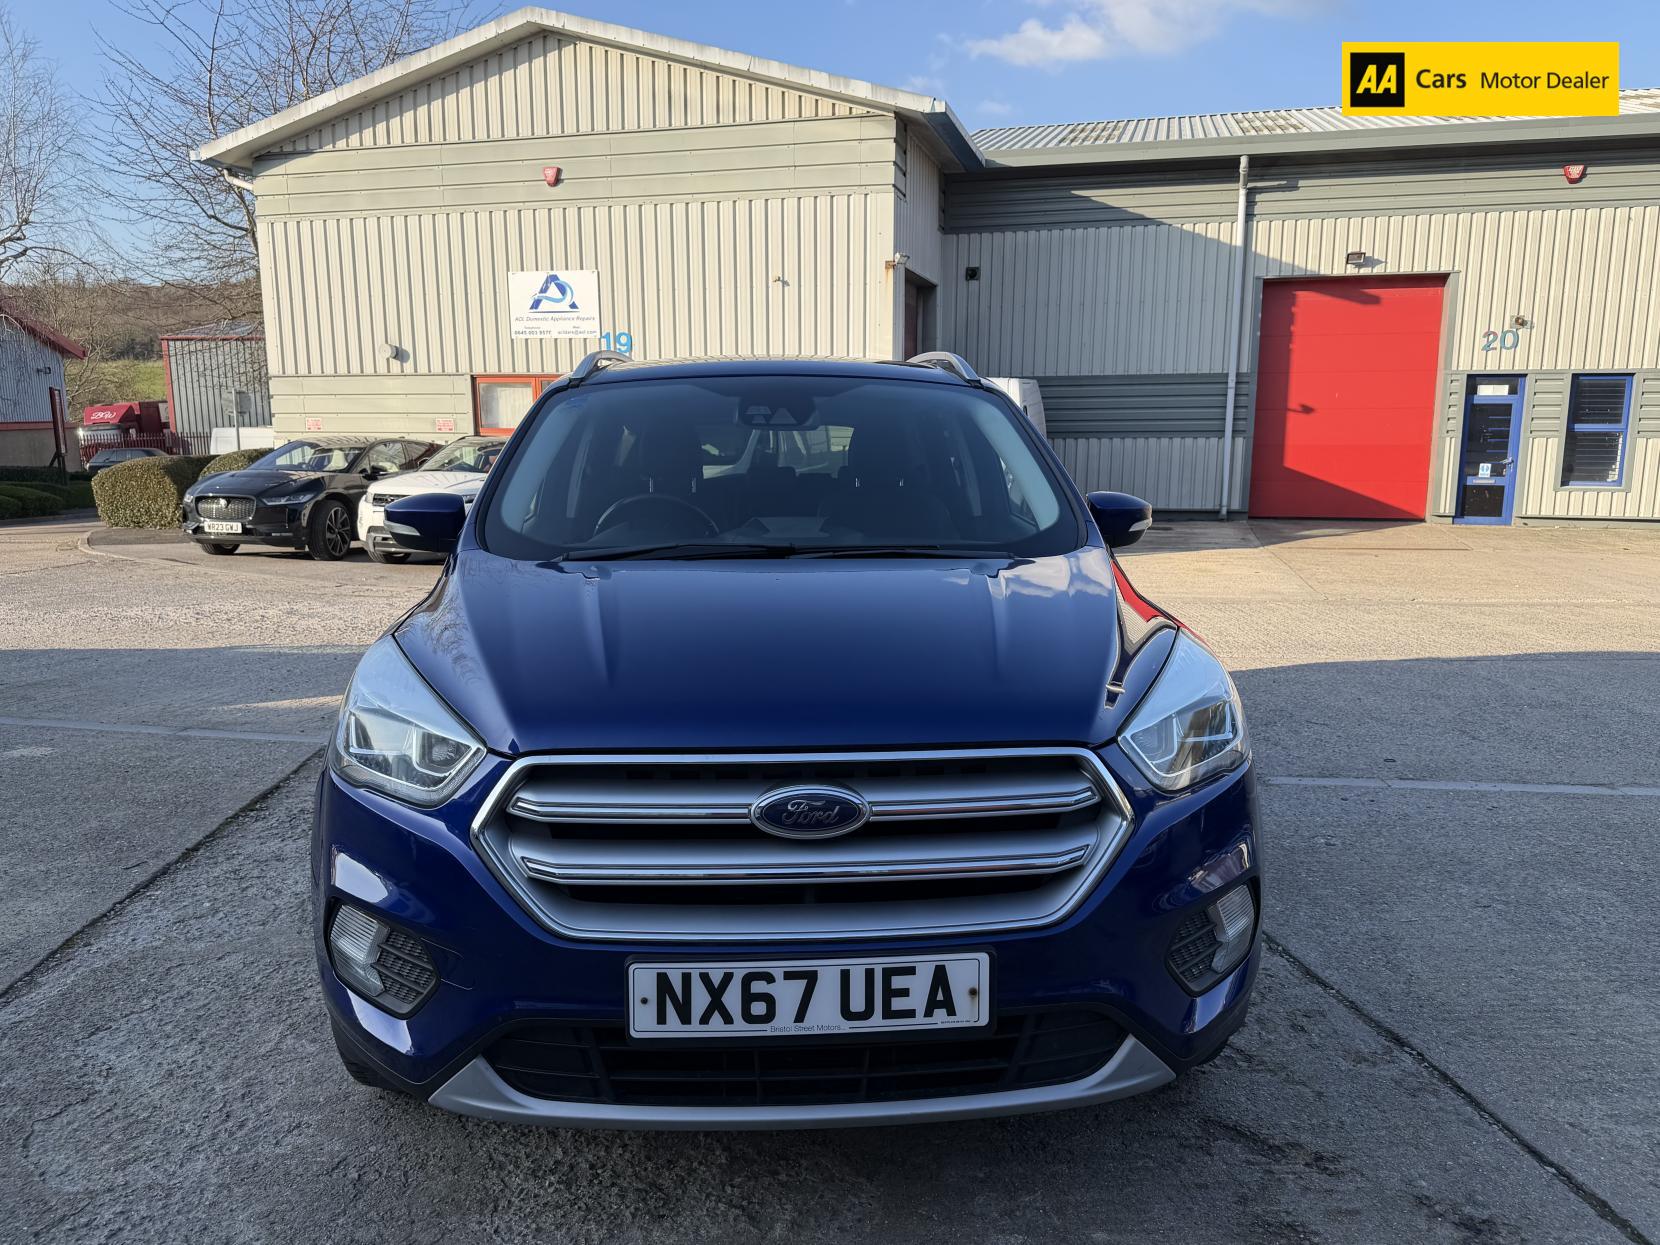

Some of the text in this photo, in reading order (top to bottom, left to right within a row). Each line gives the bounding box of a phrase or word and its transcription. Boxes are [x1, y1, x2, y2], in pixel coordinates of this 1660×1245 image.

[600, 331, 633, 354] 19
[1481, 329, 1520, 352] 20
[781, 800, 840, 825] Ford
[656, 964, 957, 1026] NX67 UEA
[794, 1024, 815, 1032] Street
